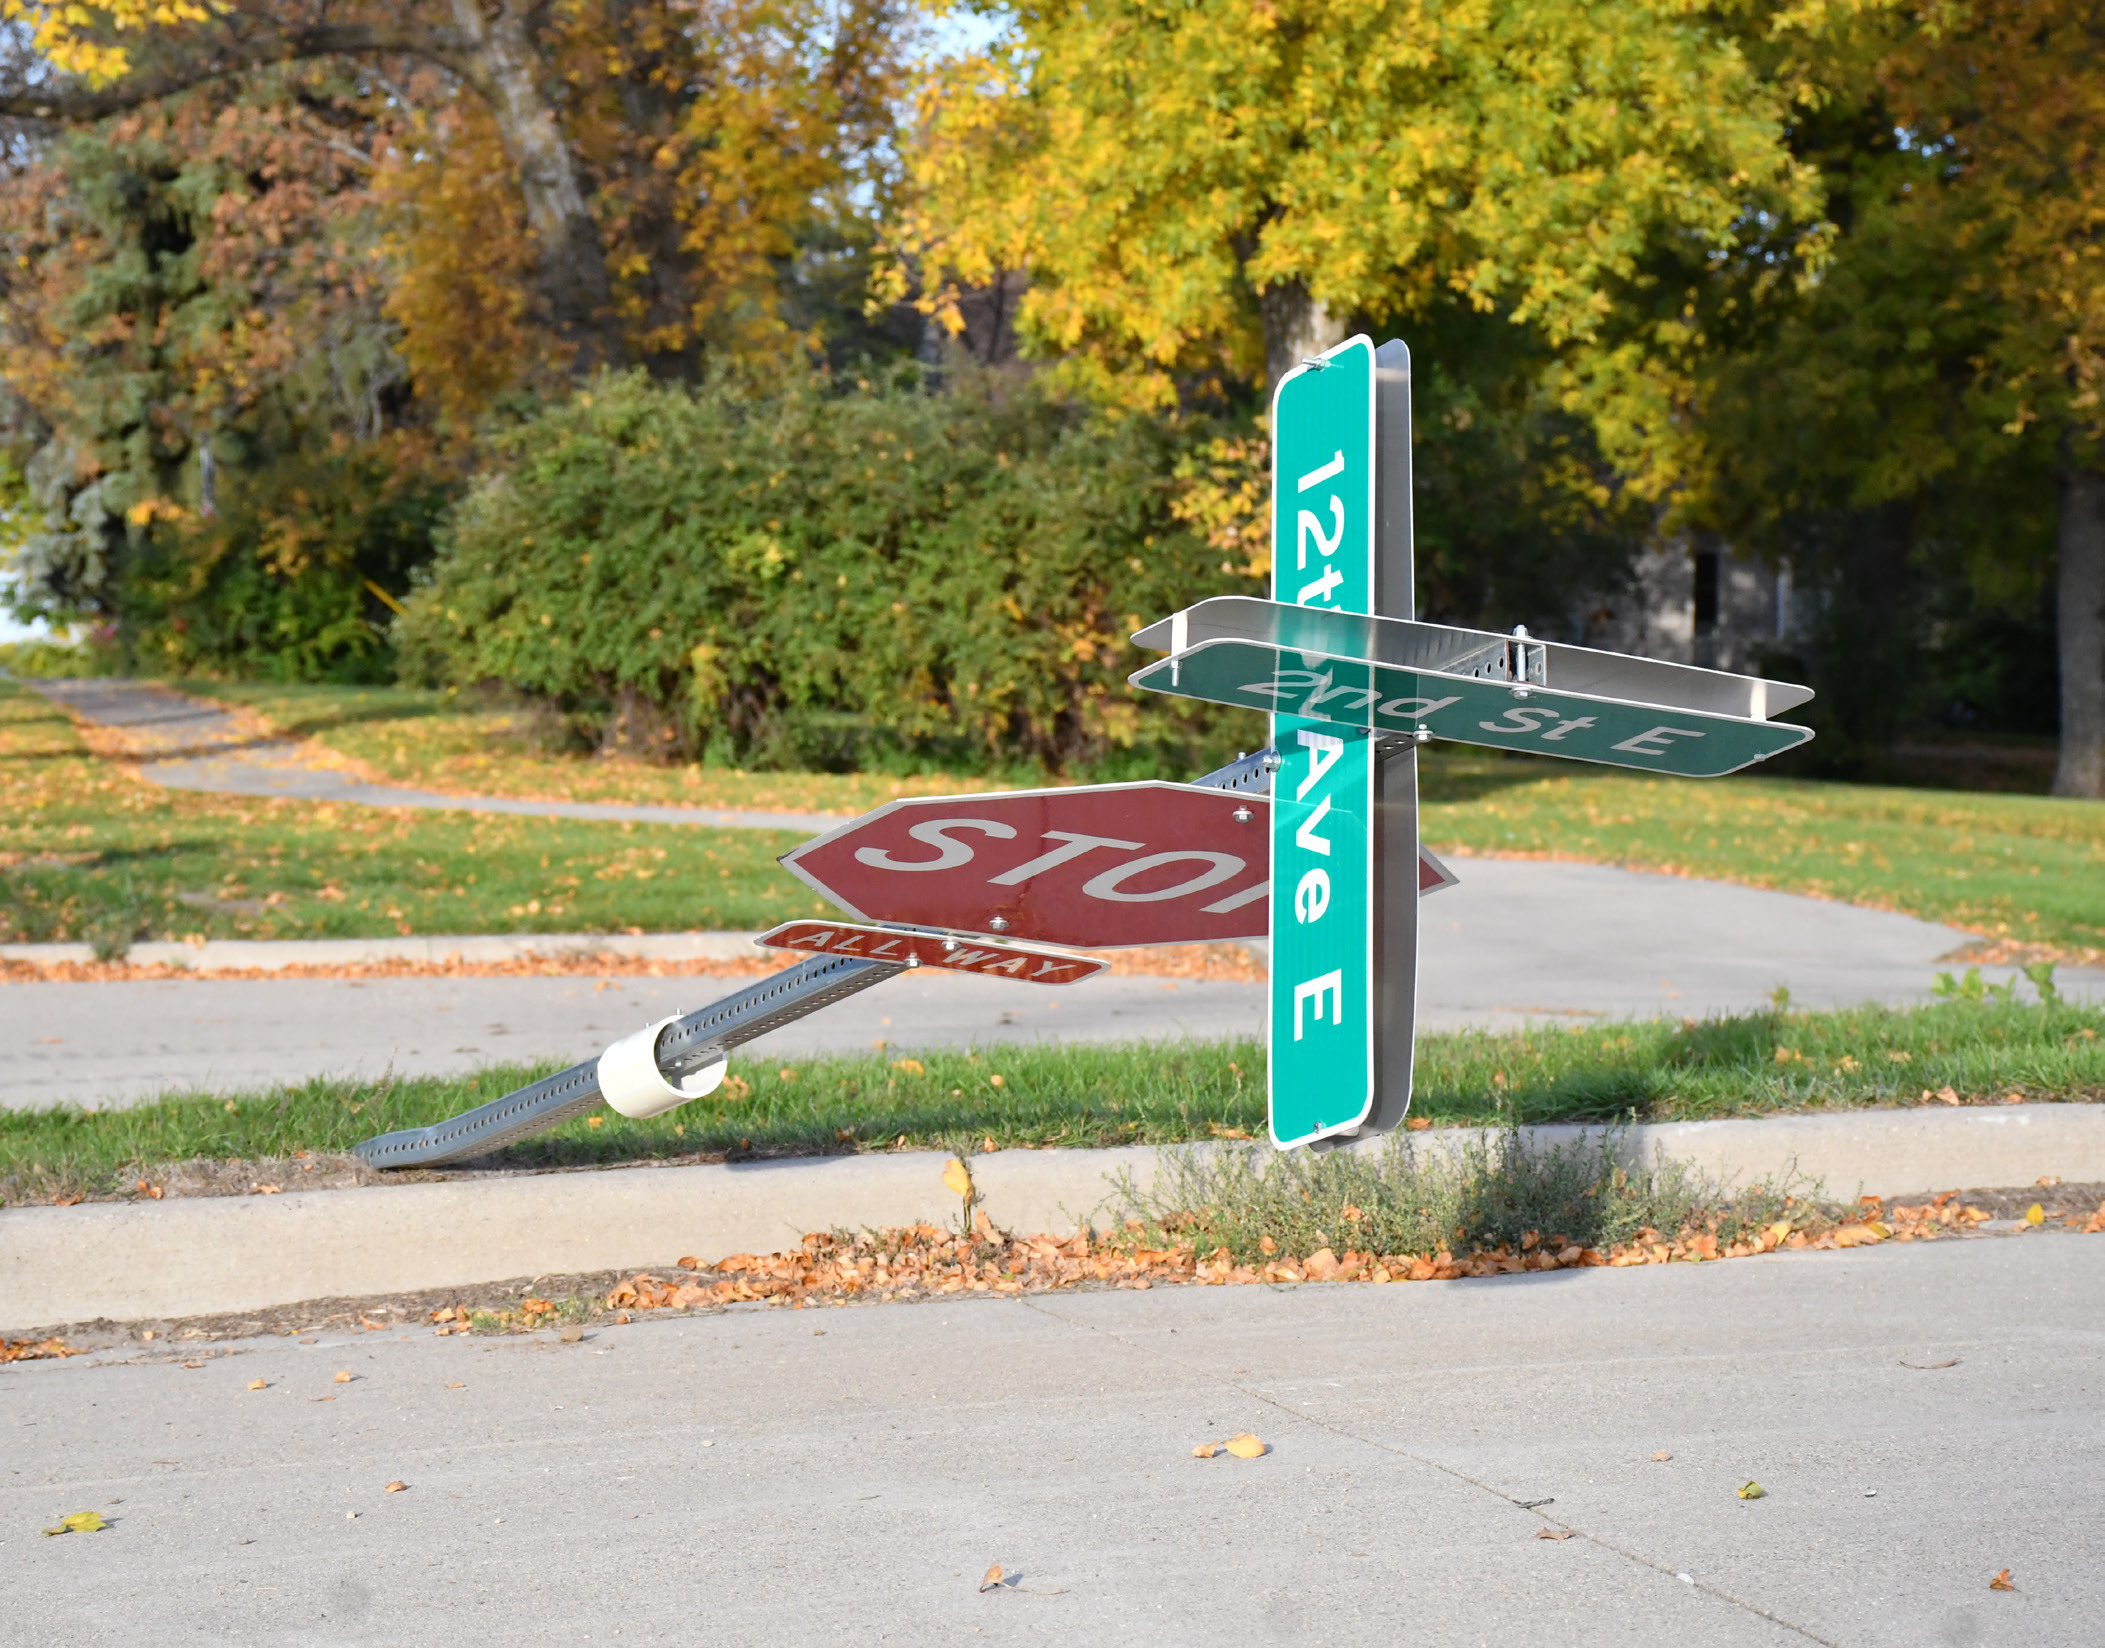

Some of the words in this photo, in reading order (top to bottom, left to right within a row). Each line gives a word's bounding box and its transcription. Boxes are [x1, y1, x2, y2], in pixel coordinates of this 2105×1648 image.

[1297, 449, 1345, 614] 12t
[1237, 669, 1464, 719] 2nd
[1479, 707, 1596, 741] St
[1609, 725, 1707, 756] E
[1295, 729, 1344, 924] Ave
[788, 930, 903, 957] ALL
[942, 948, 1075, 978] WAY
[1293, 968, 1342, 1042] E
